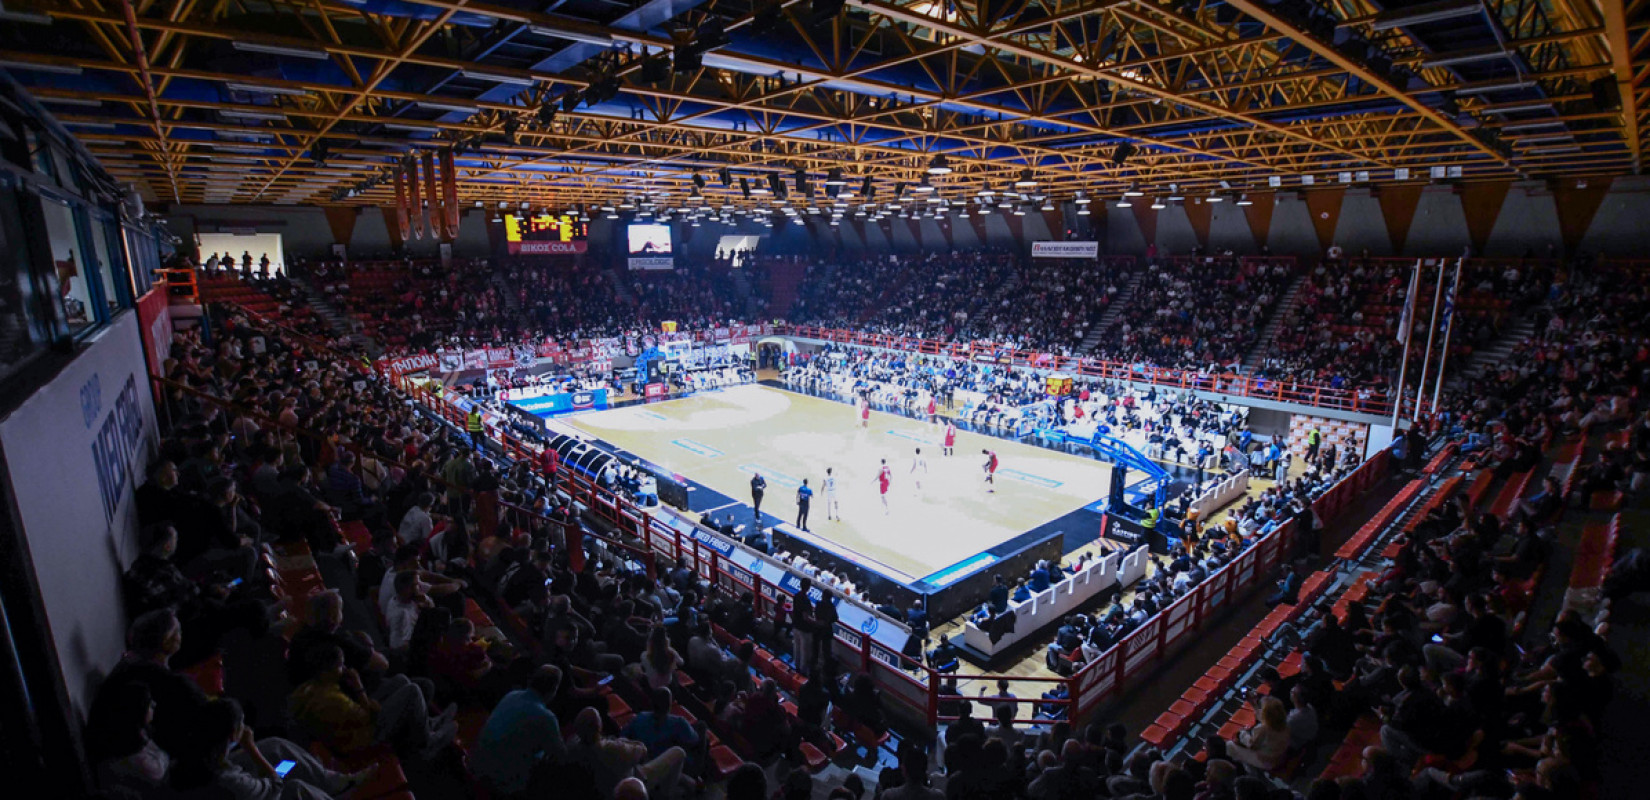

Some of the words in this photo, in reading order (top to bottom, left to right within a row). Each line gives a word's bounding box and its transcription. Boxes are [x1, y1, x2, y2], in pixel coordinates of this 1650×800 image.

[551, 243, 577, 252] COLA
[91, 409, 127, 525] MED
[694, 530, 711, 543] MED
[708, 536, 731, 553] FRIGO
[838, 629, 859, 648] MED
